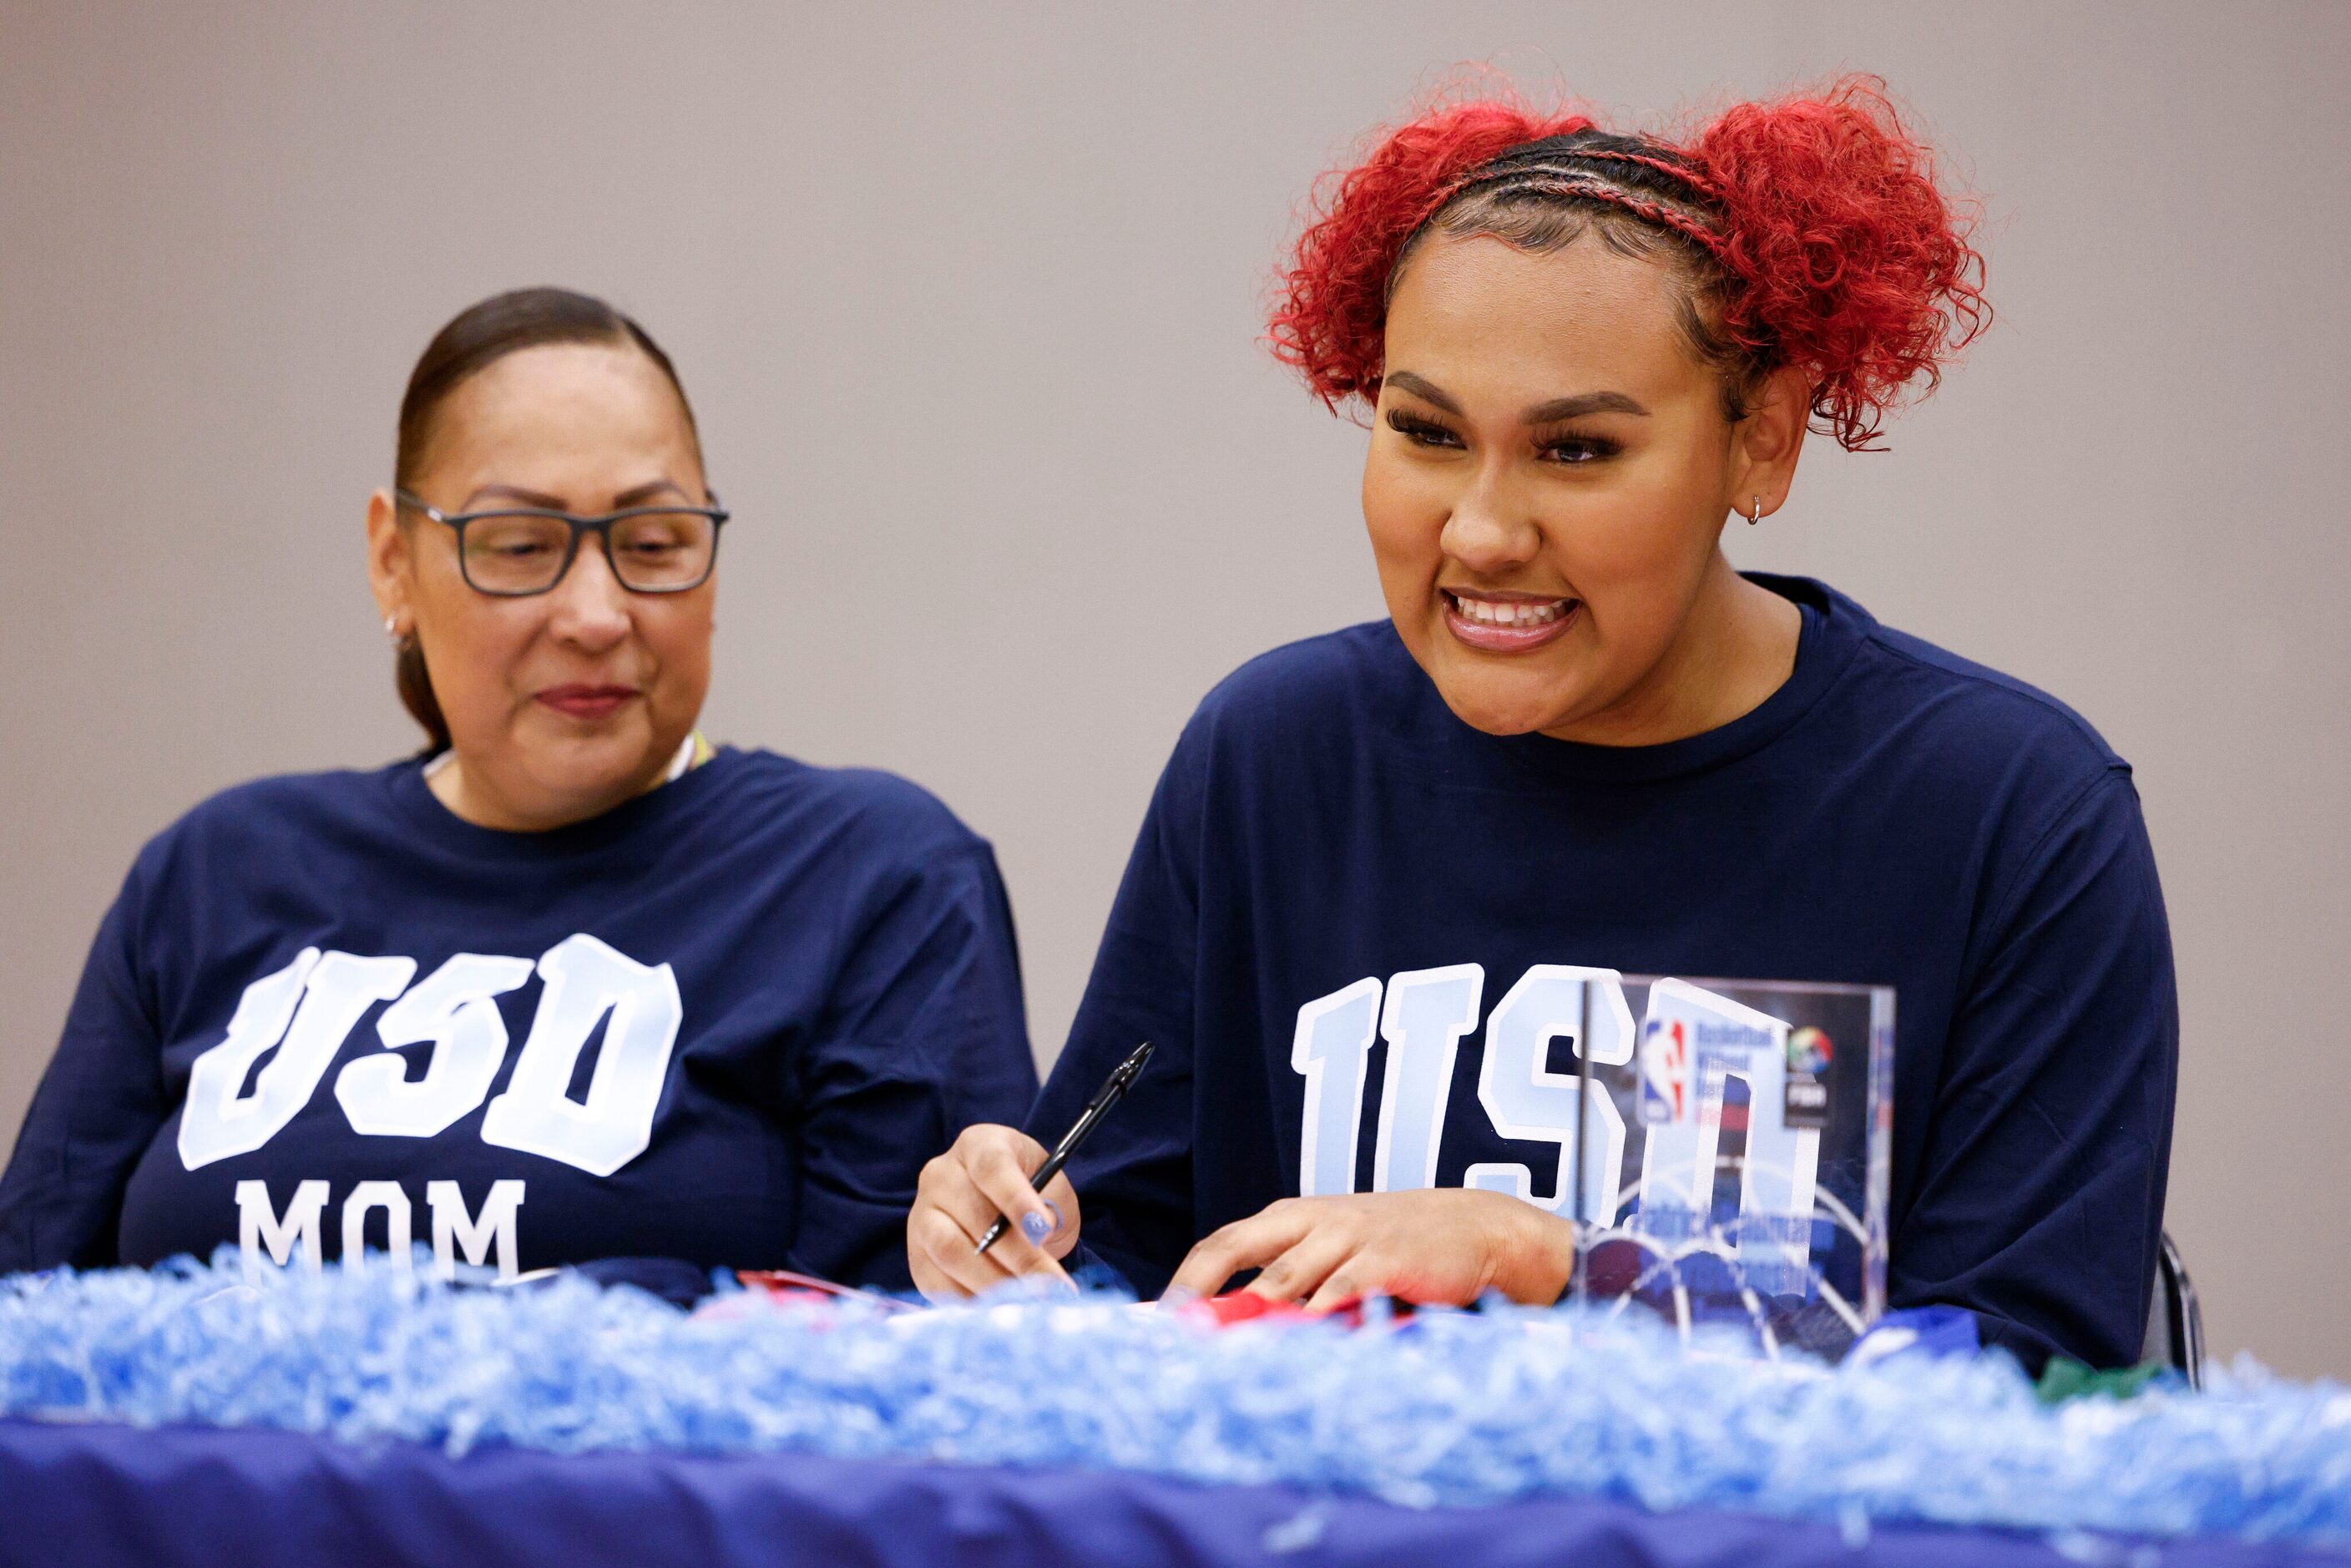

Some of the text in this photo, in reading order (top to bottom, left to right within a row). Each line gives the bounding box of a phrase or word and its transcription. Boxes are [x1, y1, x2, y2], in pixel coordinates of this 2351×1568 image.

[177, 933, 683, 1177] USD
[1291, 963, 1821, 1297] USD
[235, 1179, 526, 1282] MOM
